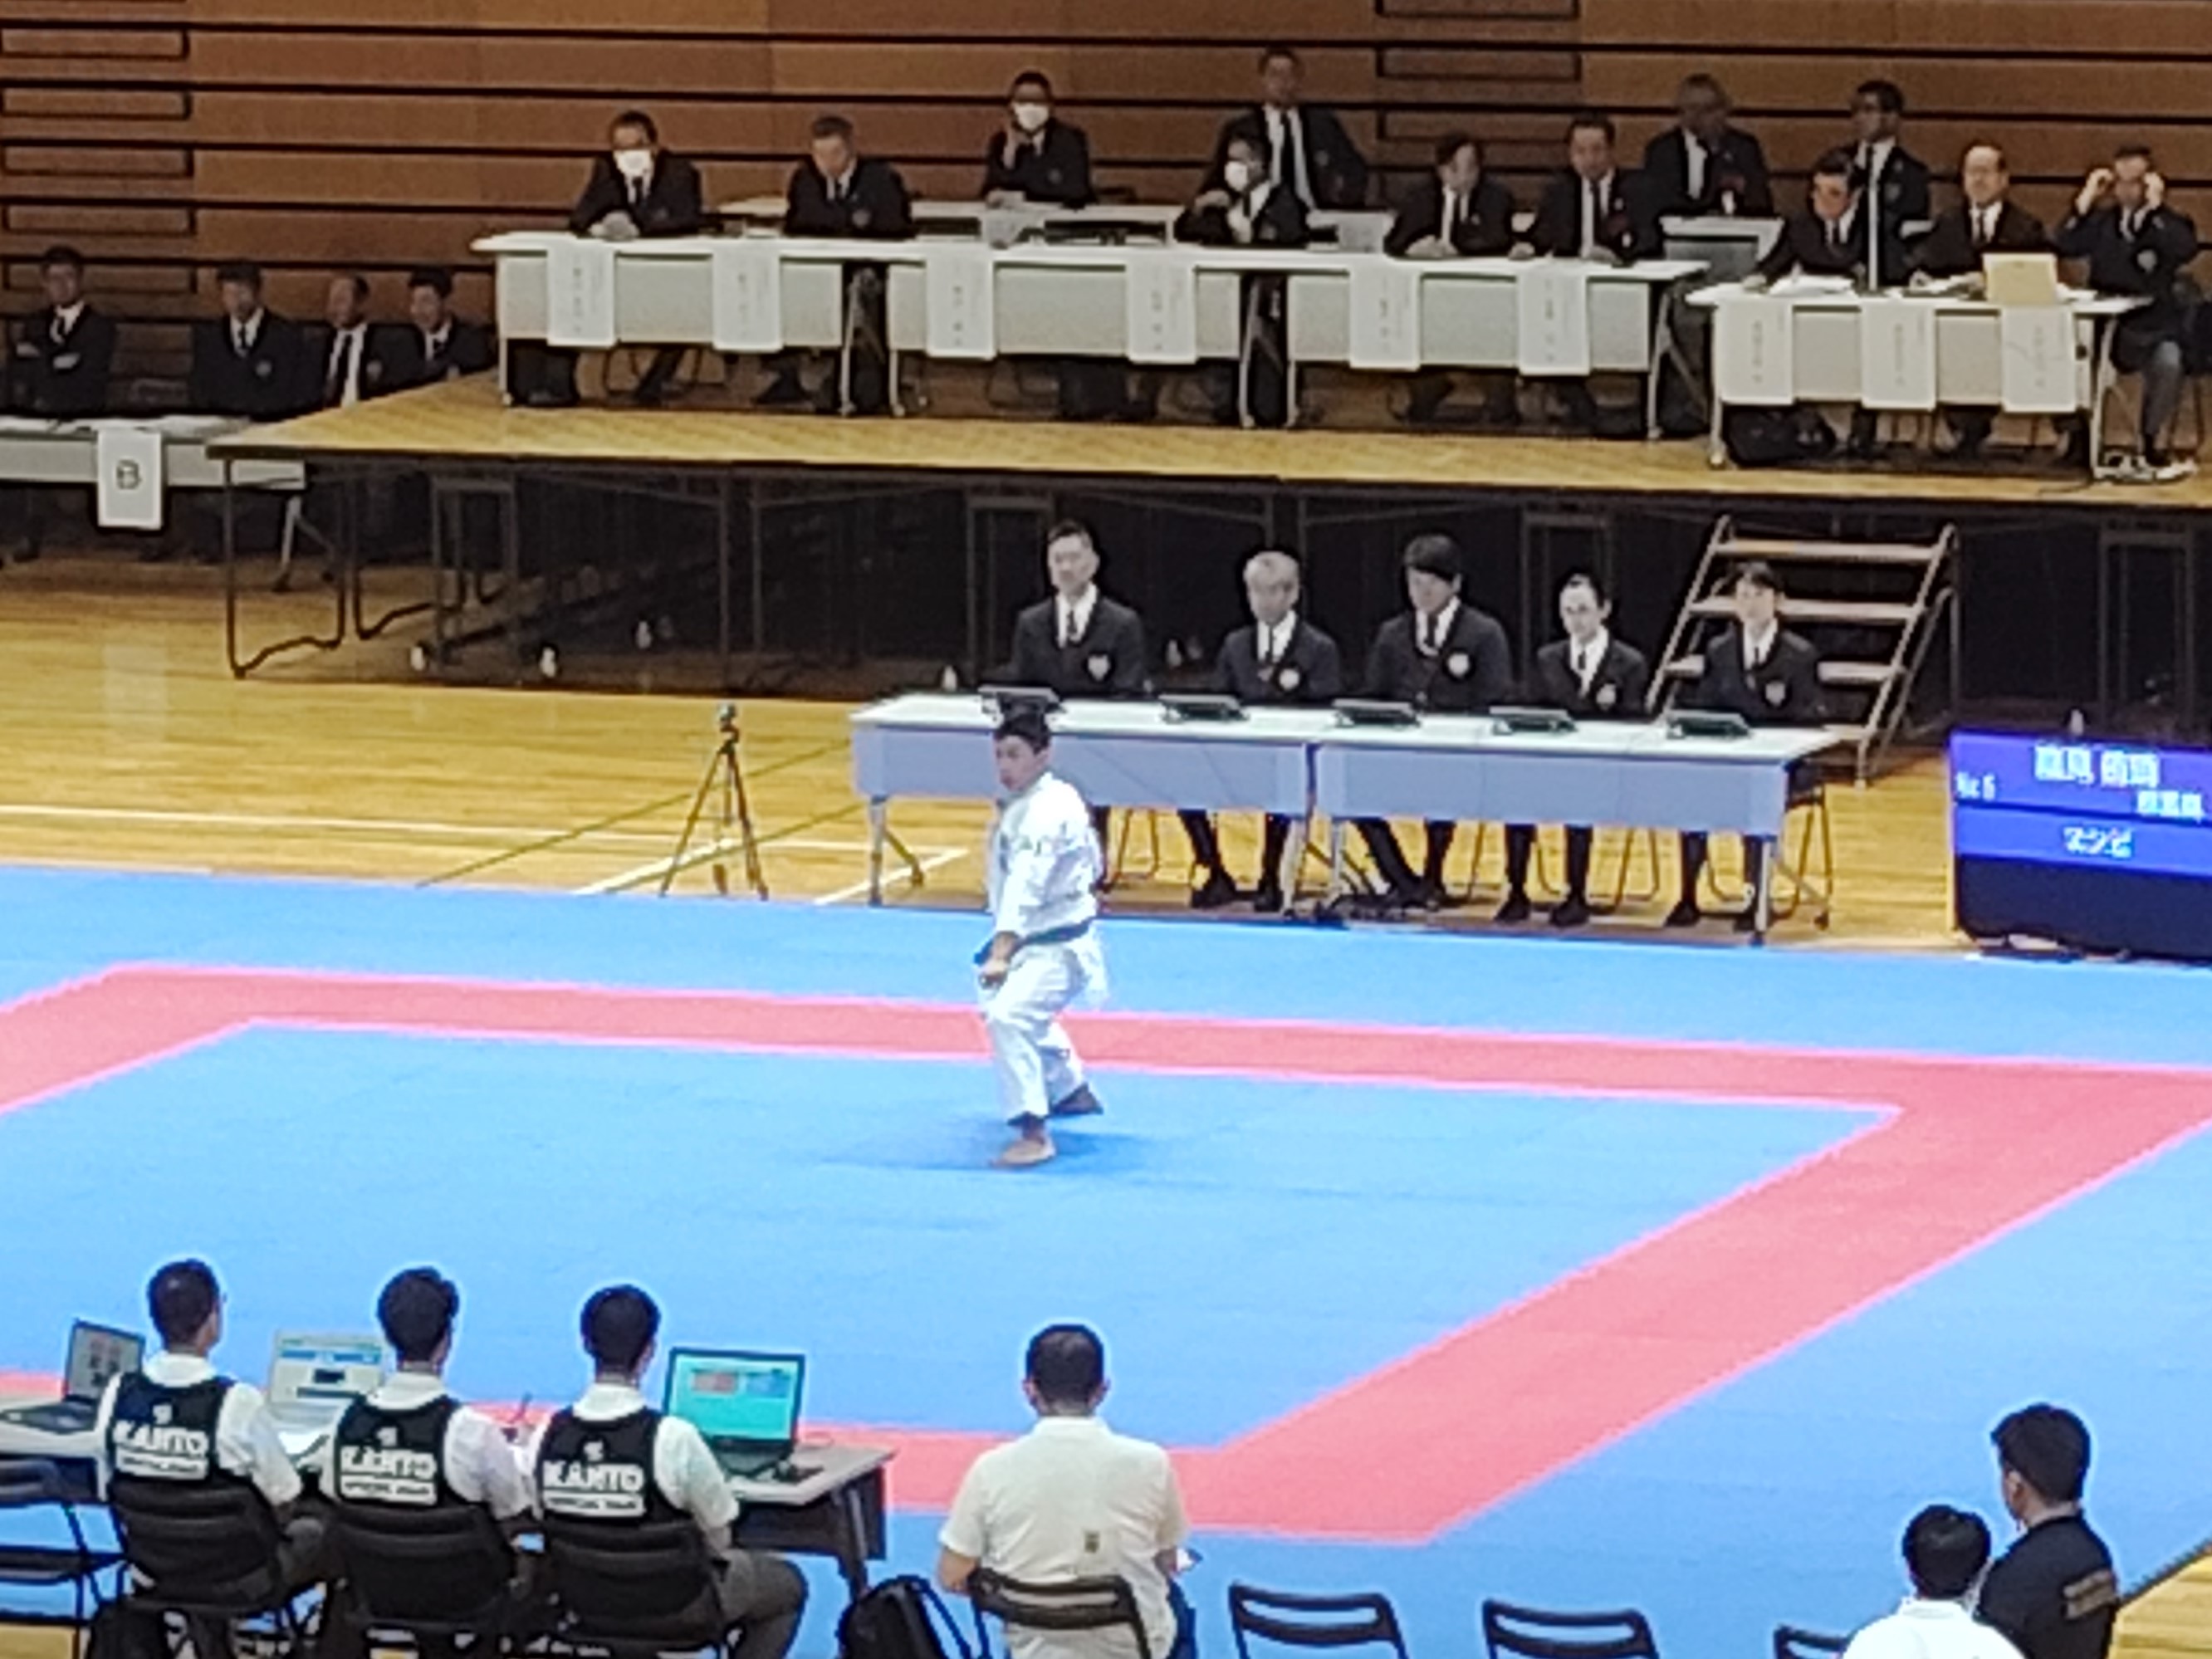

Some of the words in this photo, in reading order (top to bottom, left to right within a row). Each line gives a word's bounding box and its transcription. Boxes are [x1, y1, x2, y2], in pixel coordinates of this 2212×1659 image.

[116, 459, 142, 490] B
[113, 1418, 208, 1453] KANTO
[340, 1445, 438, 1479] KANTO
[542, 1460, 645, 1492] KANTO
